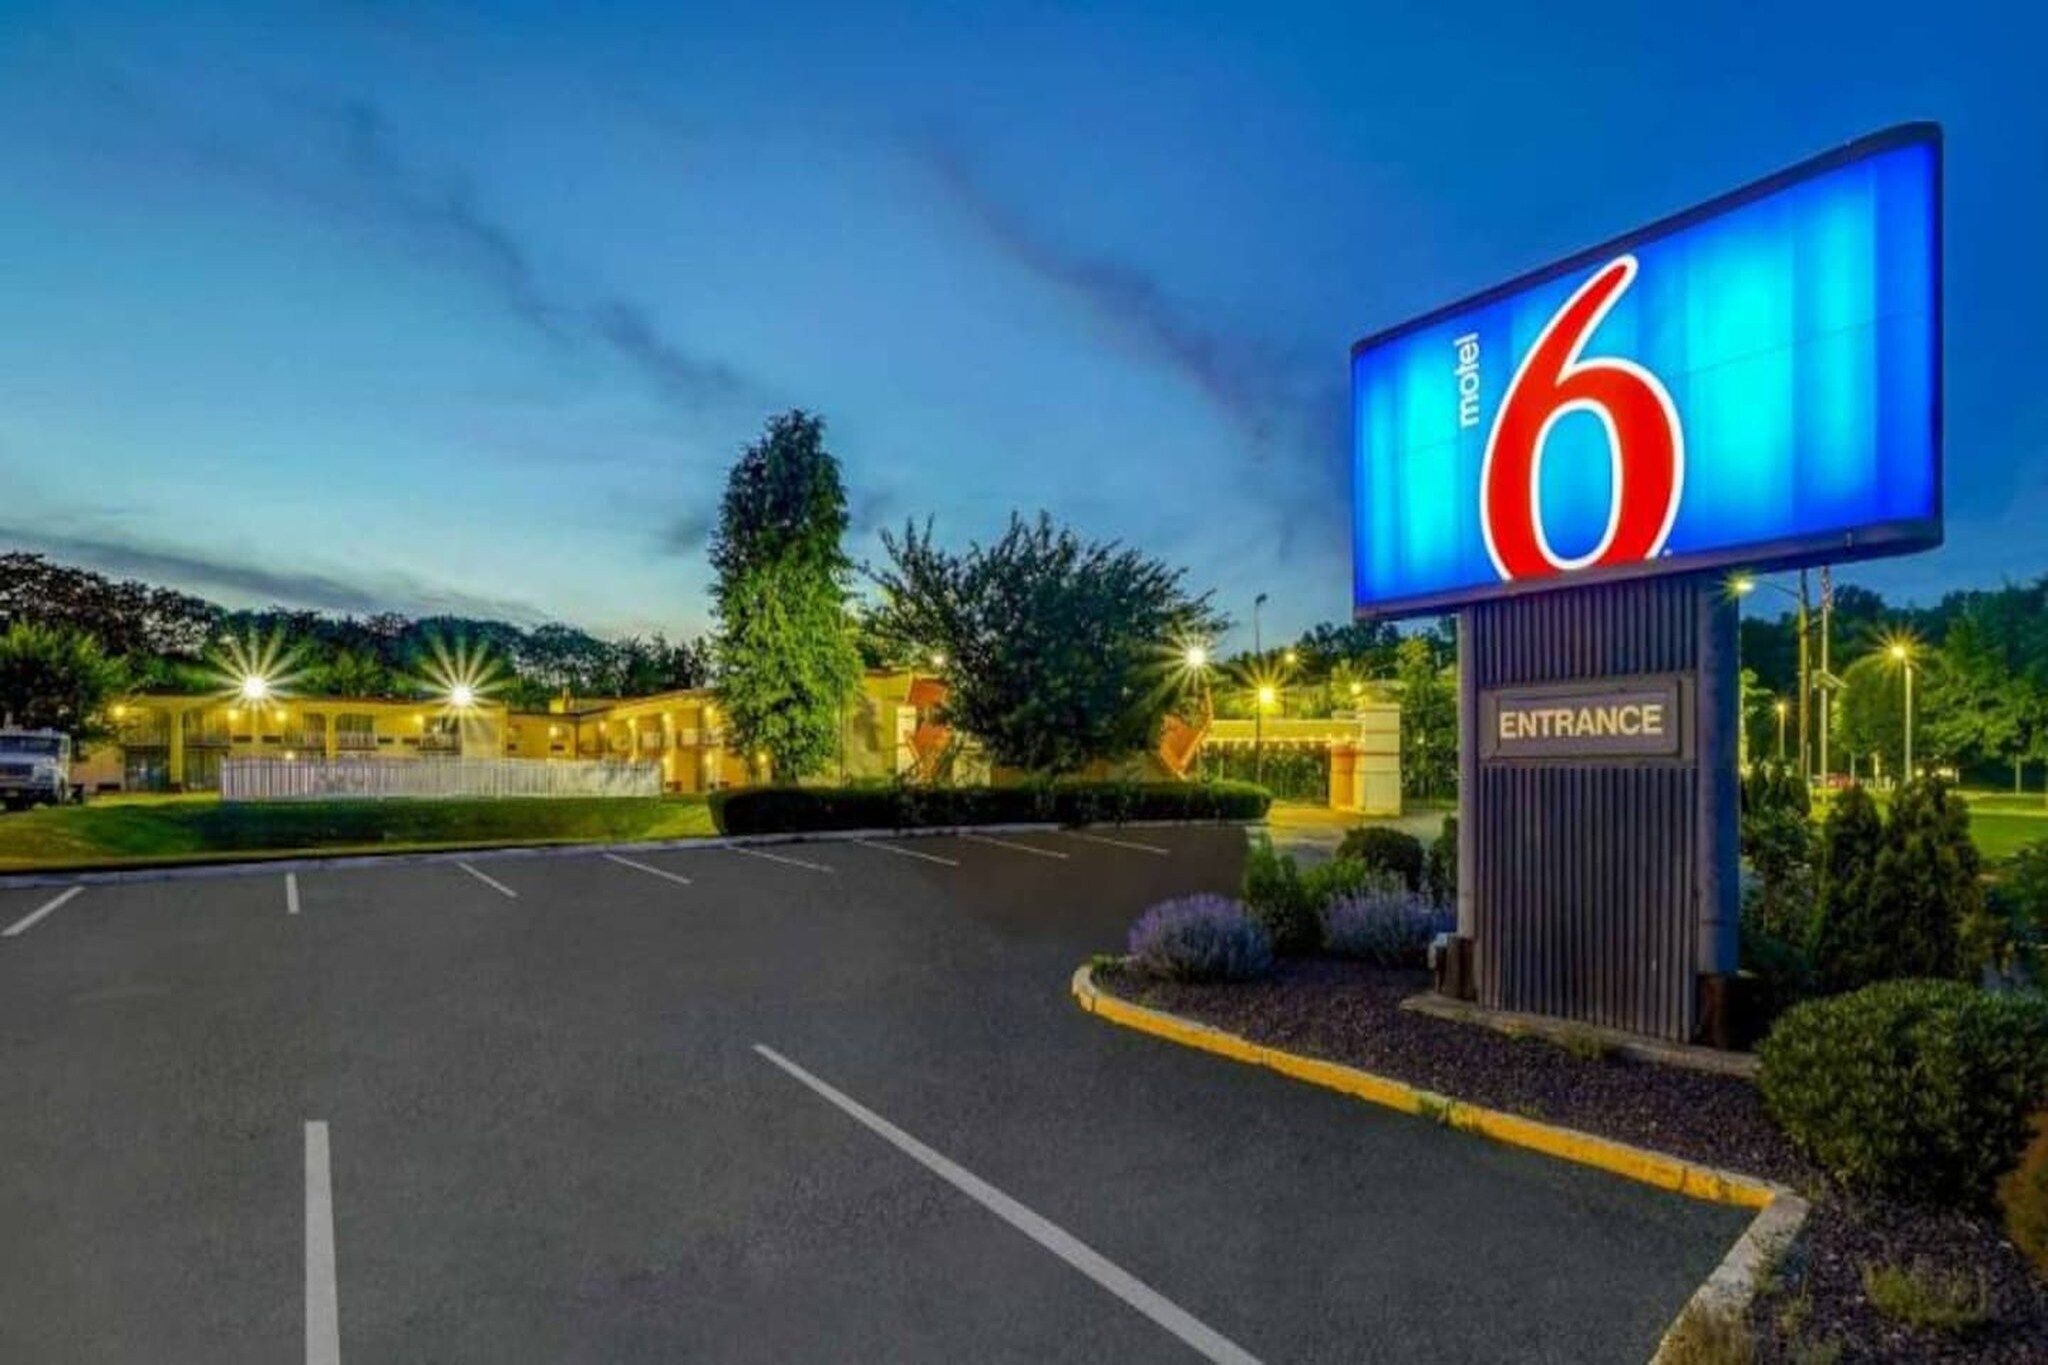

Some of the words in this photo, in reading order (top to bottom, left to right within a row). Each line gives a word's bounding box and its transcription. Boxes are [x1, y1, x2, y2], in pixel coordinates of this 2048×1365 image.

[1454, 333, 1479, 429] motel
[1481, 255, 1684, 580] 6
[1500, 705, 1663, 739] ENTRANCE
